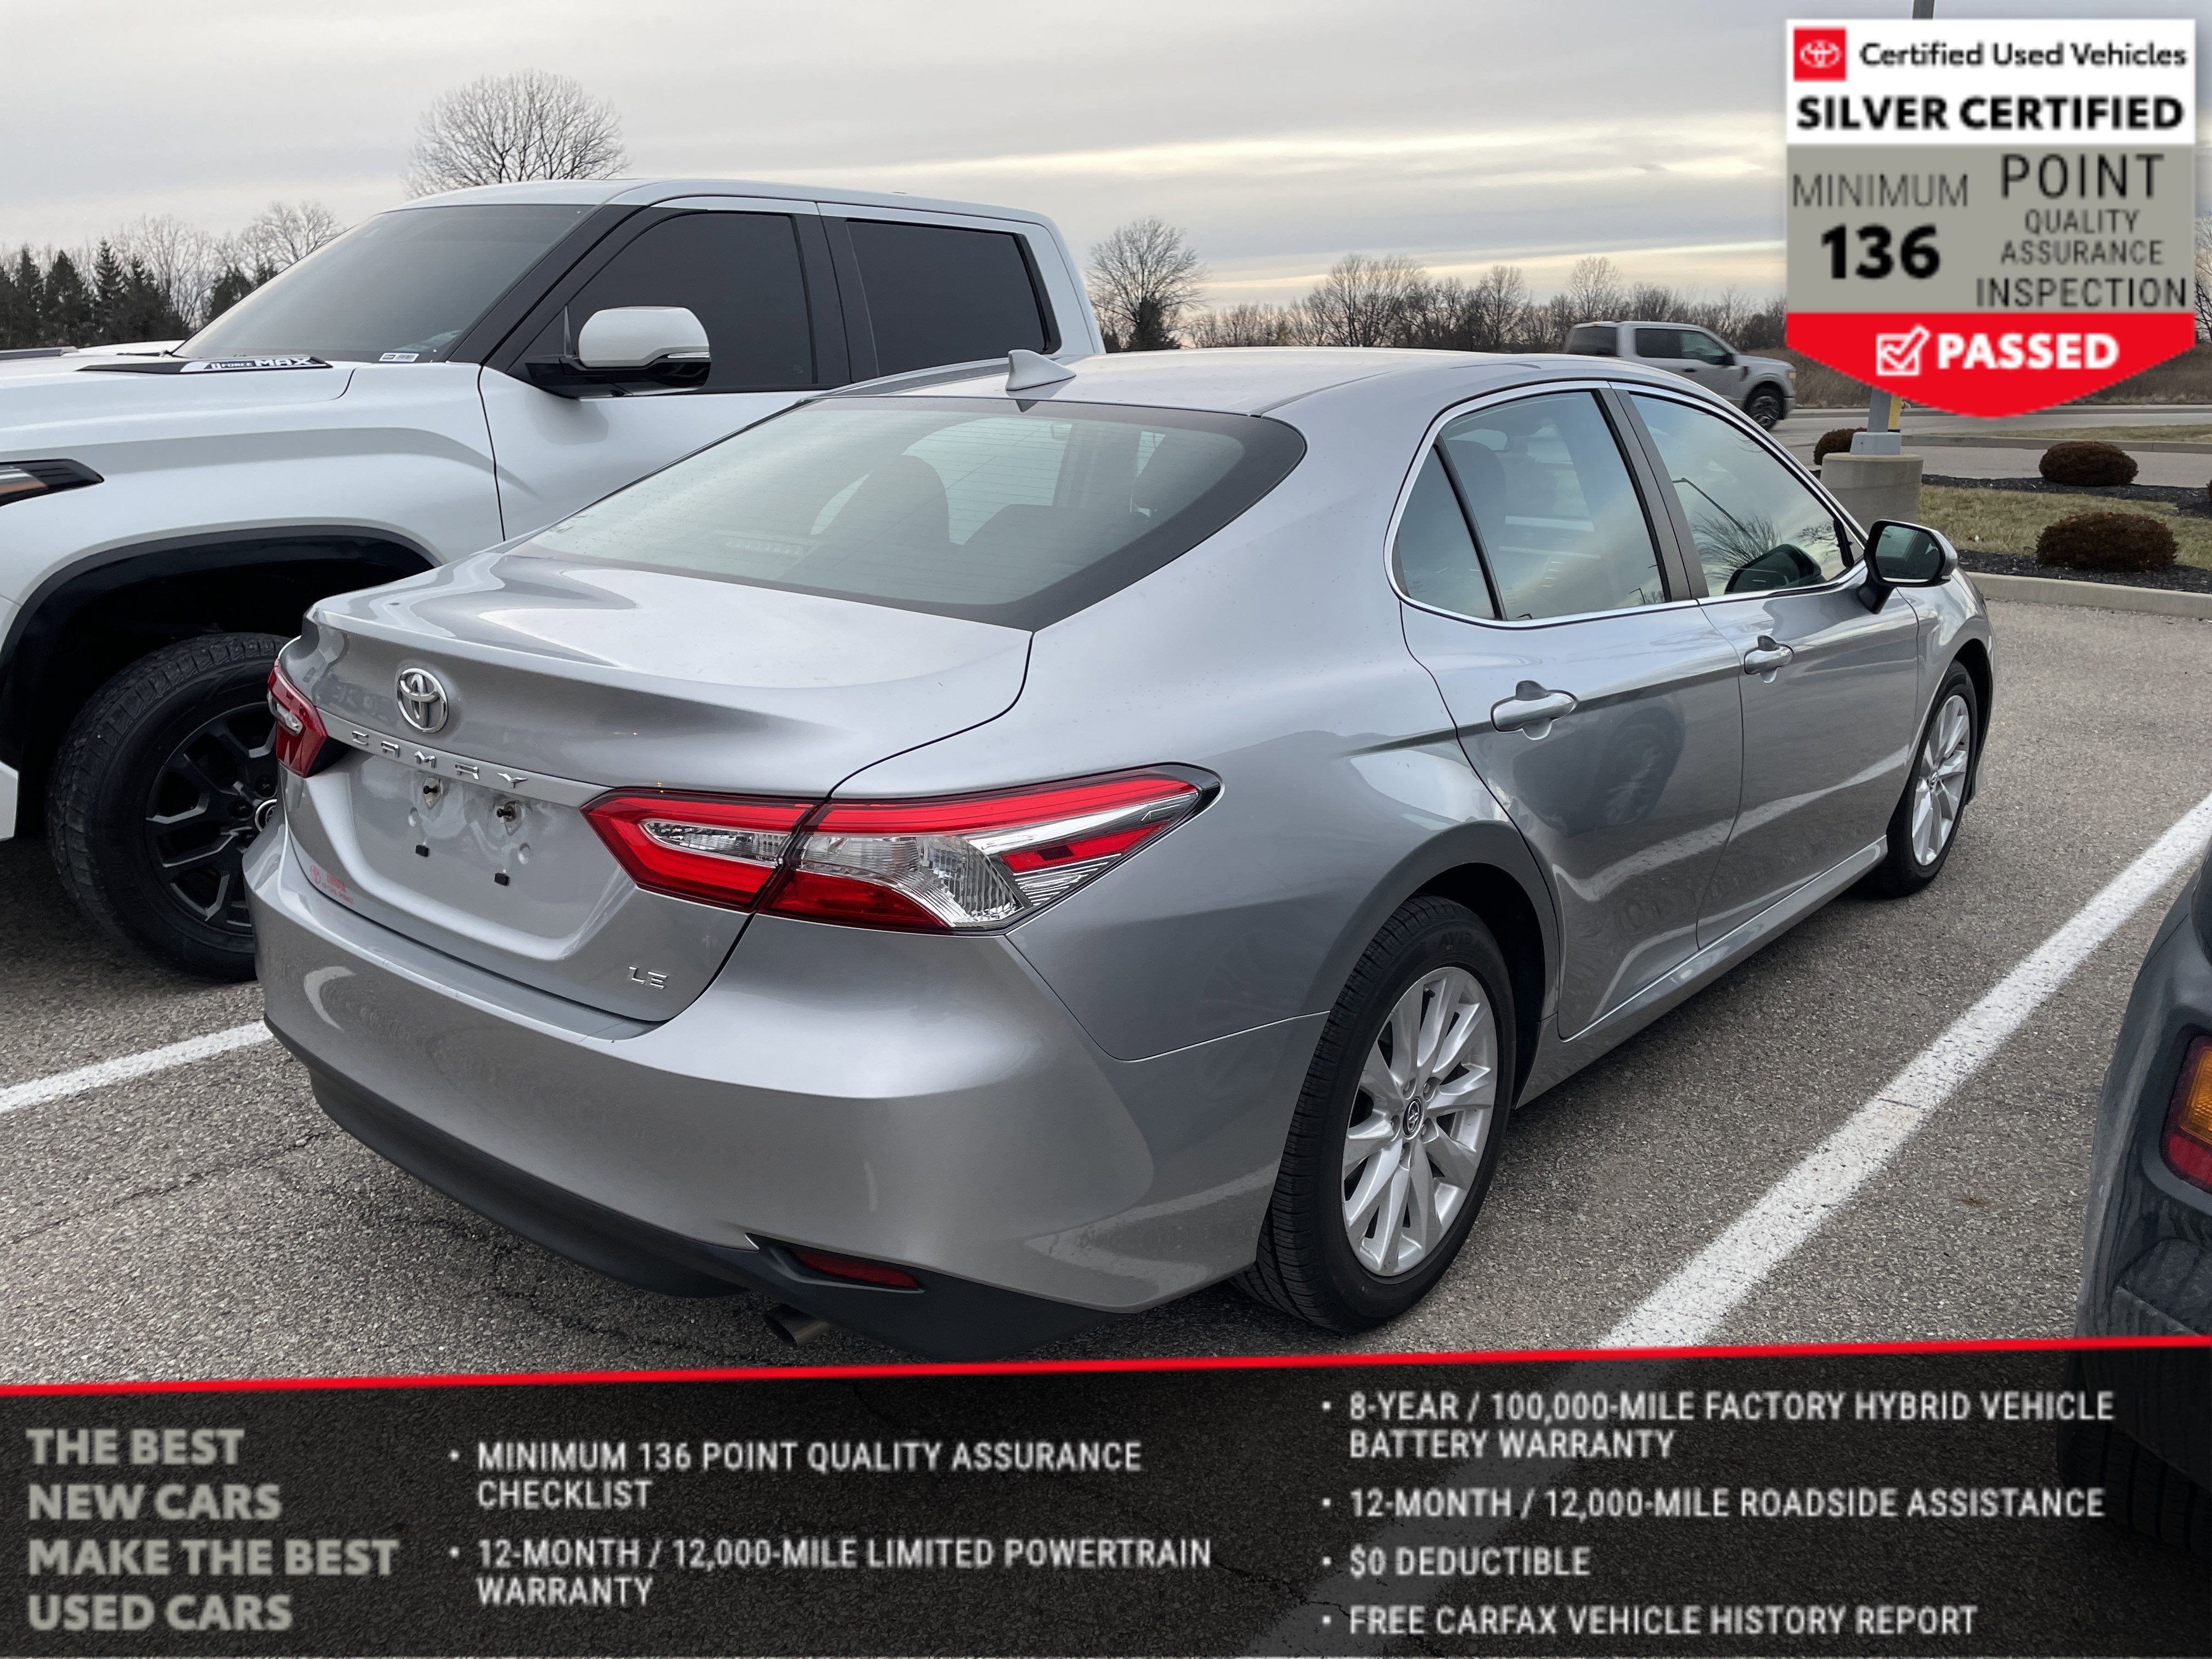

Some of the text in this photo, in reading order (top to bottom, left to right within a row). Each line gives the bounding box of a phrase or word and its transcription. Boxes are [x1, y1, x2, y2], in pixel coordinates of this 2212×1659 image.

[255, 357, 311, 367] MAX
[352, 731, 528, 788] CAMRY
[629, 966, 668, 990] LE
